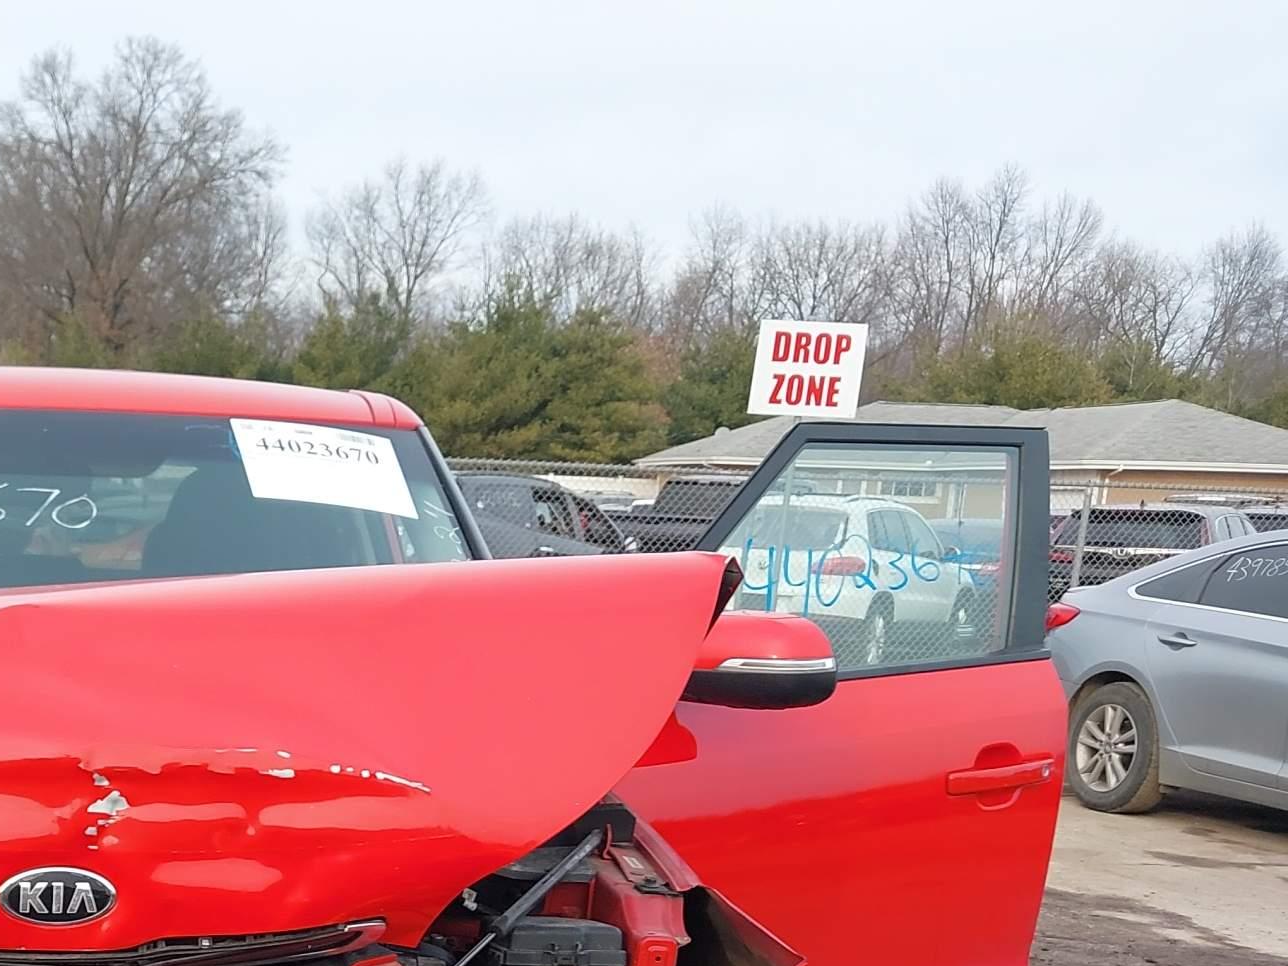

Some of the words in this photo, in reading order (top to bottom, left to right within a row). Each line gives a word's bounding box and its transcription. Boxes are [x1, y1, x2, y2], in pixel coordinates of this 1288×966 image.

[771, 331, 852, 365] DROP
[768, 374, 842, 407] ZONE
[256, 437, 380, 465] 44023670
[18, 881, 98, 914] KIA
